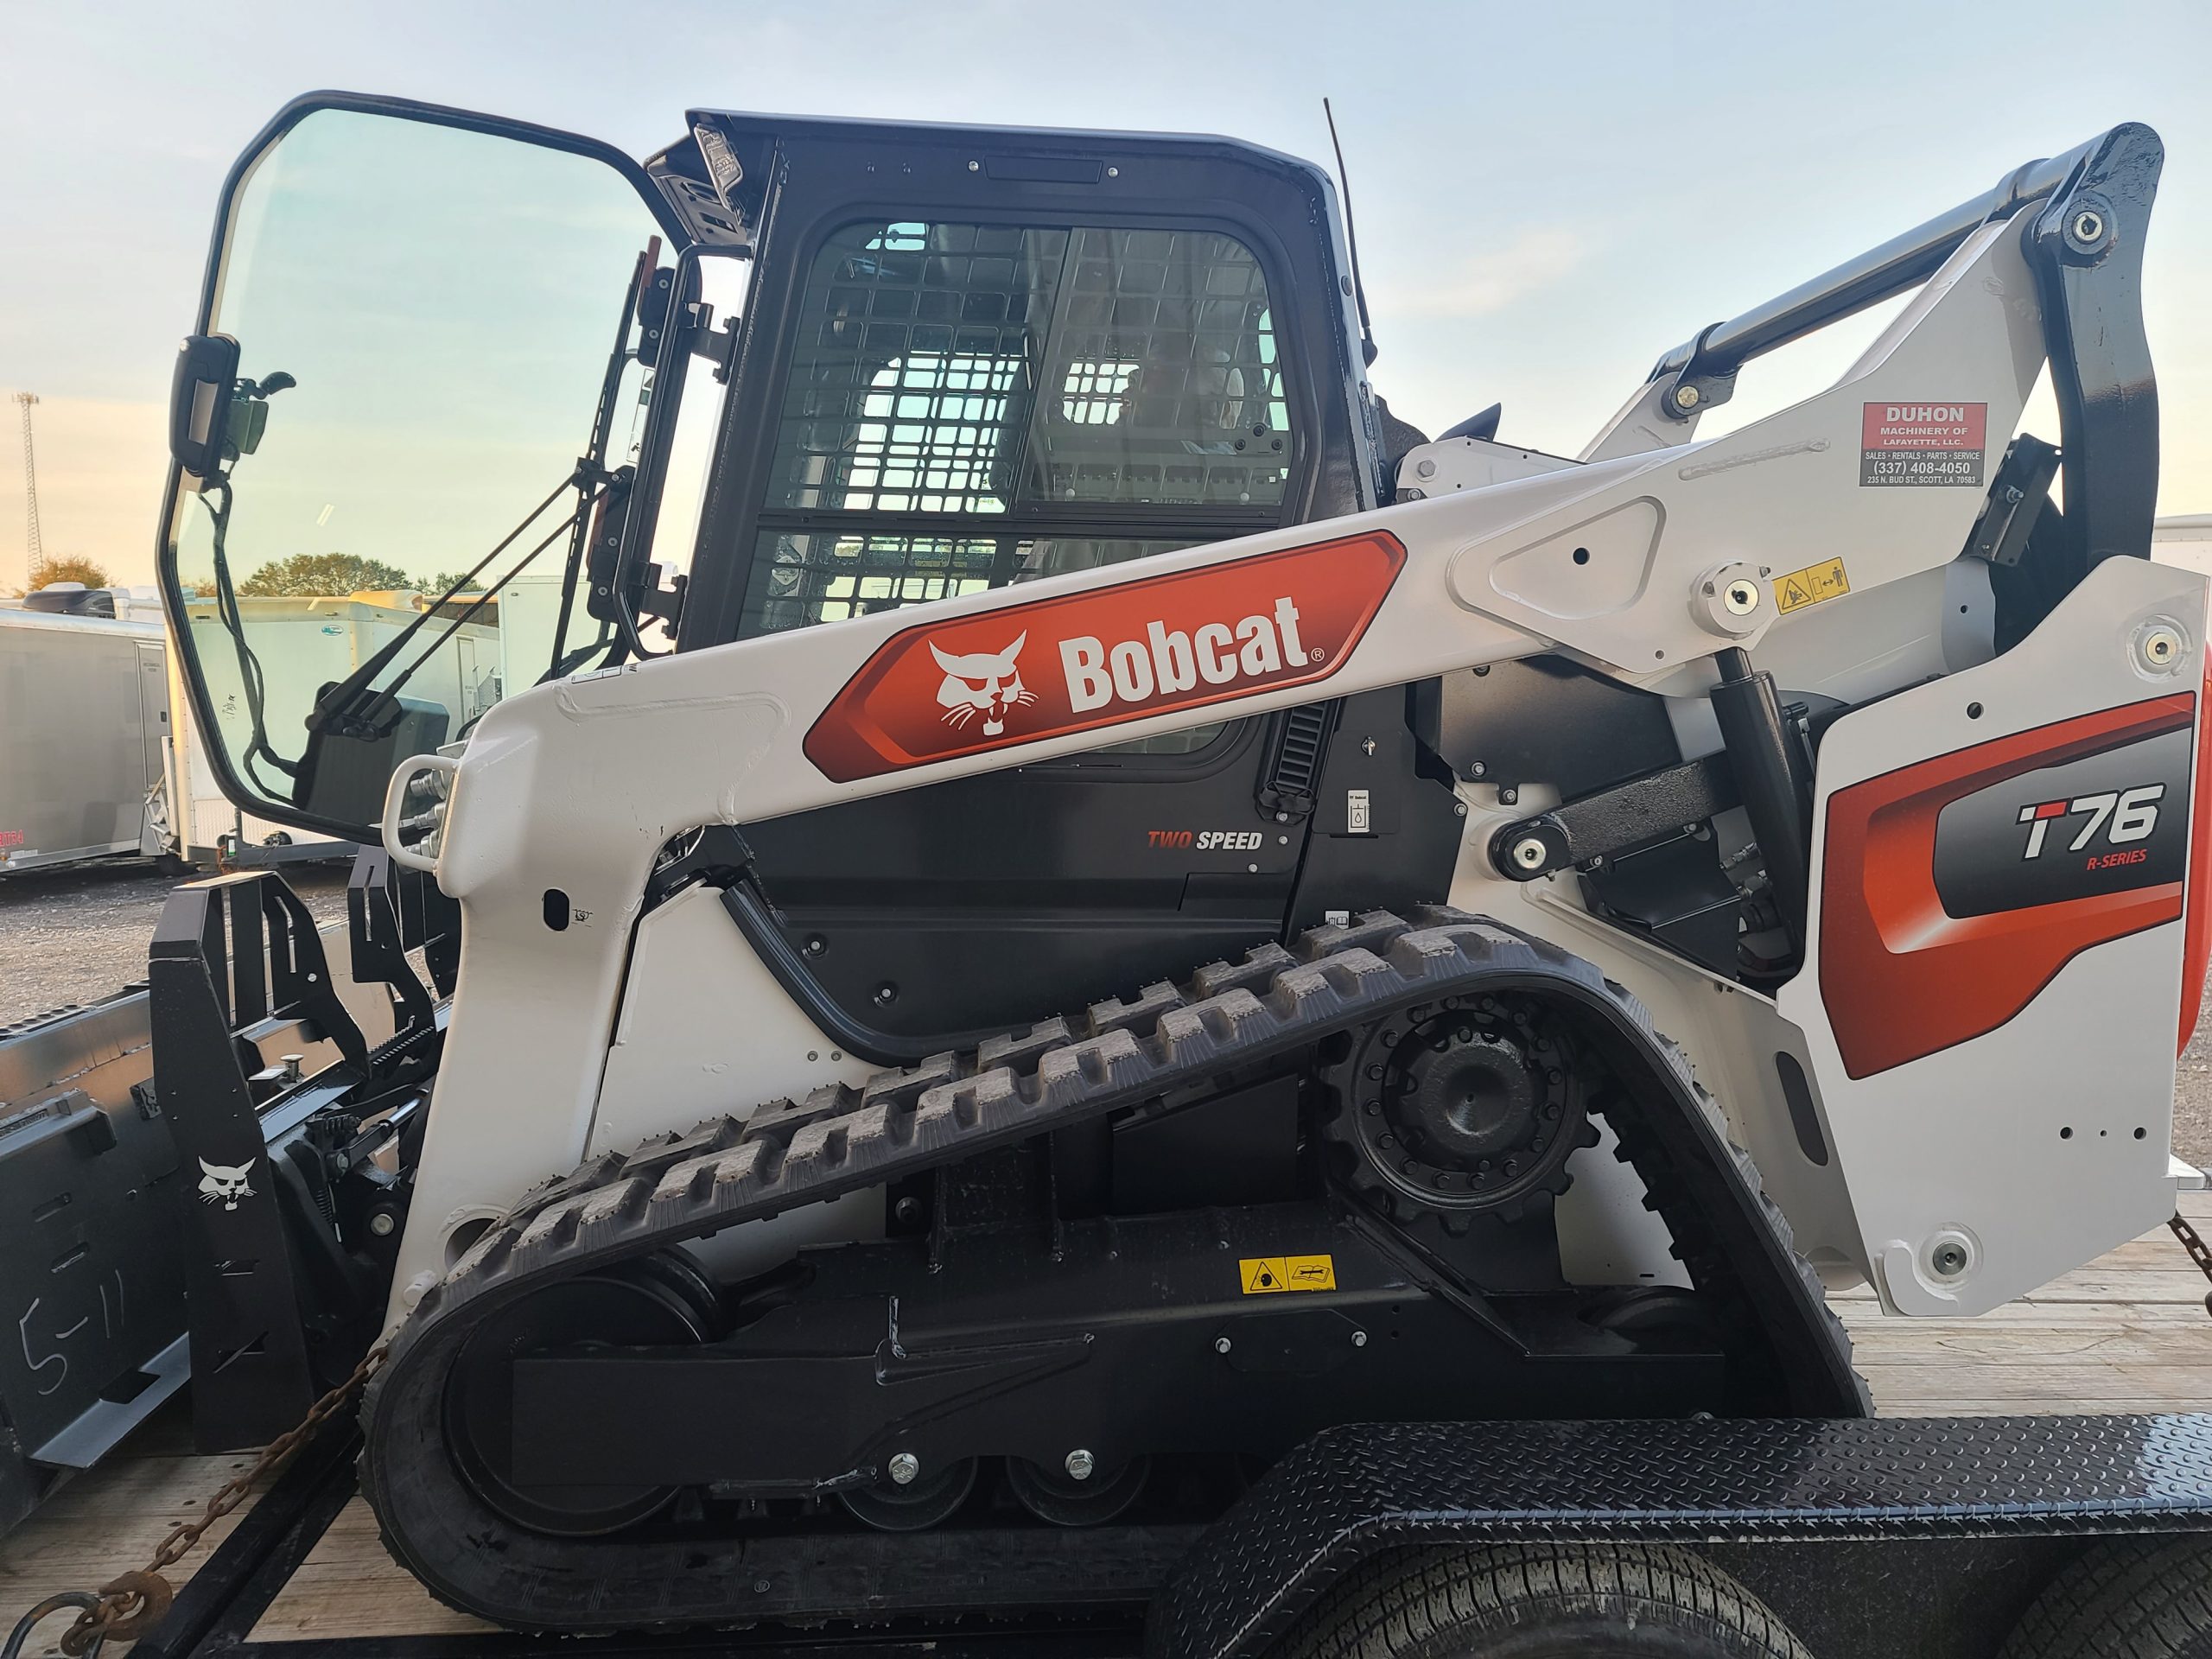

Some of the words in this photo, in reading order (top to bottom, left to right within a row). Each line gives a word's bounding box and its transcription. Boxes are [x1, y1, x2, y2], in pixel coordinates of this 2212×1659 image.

[1886, 406, 1964, 423] DUHON
[1880, 427, 1950, 435] MACHINERY
[1953, 427, 1969, 435] OF
[1866, 451, 1886, 460] SALES
[1891, 451, 1921, 460] RENTALS
[1927, 451, 1948, 460] PARTS
[1953, 451, 1980, 460] SERVICE
[1873, 460, 1907, 475] (337)
[1910, 461, 1970, 474] 408-4050
[1866, 475, 1879, 484] 235
[1880, 475, 1888, 484] N.
[1889, 475, 1904, 484] BUD
[1918, 475, 1943, 485] SCOTT,
[1944, 475, 1954, 484] LA
[1956, 475, 1976, 484] 70583
[2018, 784, 2166, 860] T76
[1147, 830, 1193, 849] TWO
[1196, 830, 1263, 850] SPEED
[2086, 849, 2148, 871] R-SERIES
